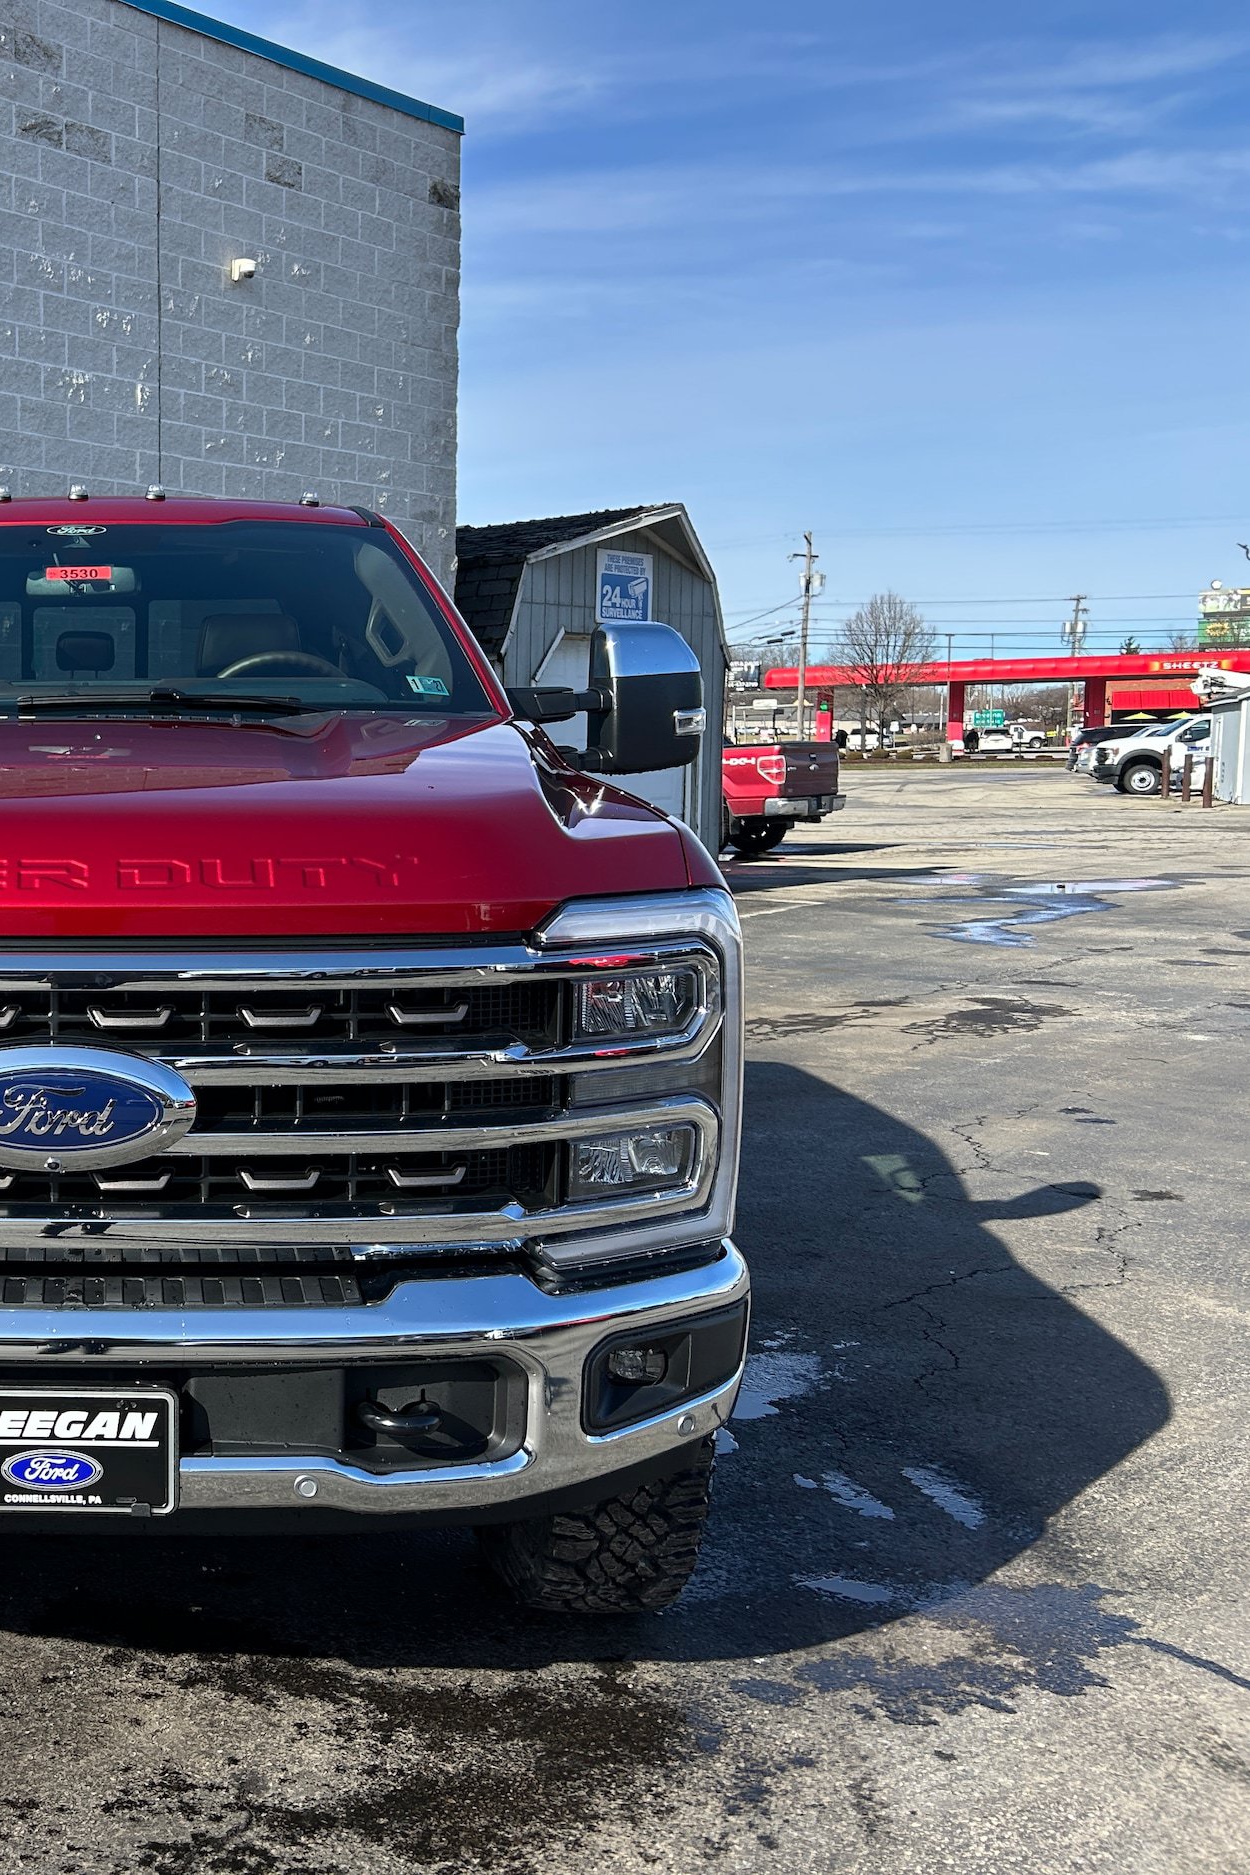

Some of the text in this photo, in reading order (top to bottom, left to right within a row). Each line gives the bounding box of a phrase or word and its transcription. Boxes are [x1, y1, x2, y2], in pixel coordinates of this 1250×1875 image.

[56, 525, 97, 535] Ford
[607, 554, 621, 563] THESE
[60, 568, 98, 579] 3530
[604, 563, 646, 576] ARE PROTECTED BY
[603, 585, 636, 609] 24 HOUR
[602, 607, 643, 620] SURVEILLANCE
[1162, 661, 1219, 670] SHEETZ
[116, 854, 419, 889] DUTY
[23, 1456, 79, 1482] Ford
[3, 1493, 102, 1506] CONNELLSVILLE, PA
